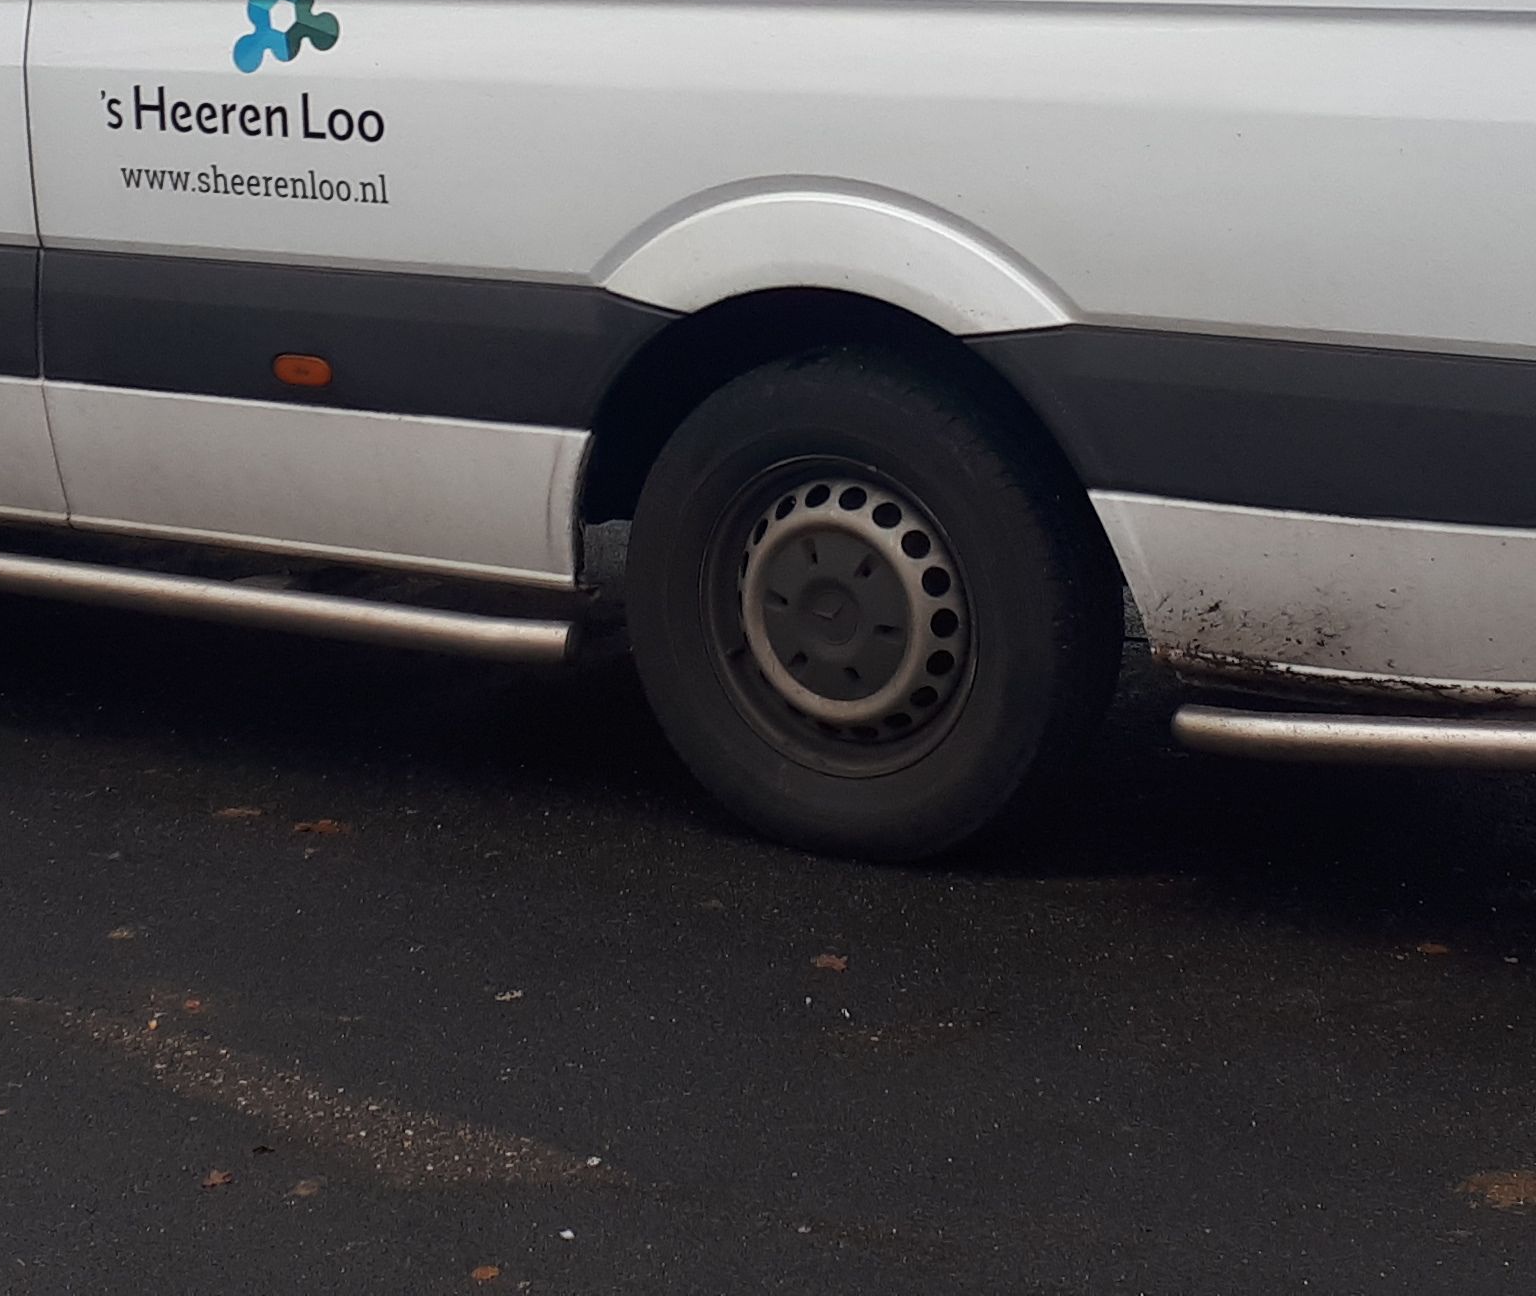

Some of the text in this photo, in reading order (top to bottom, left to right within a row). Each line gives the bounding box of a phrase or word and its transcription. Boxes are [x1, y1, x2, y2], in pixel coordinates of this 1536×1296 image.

[133, 82, 289, 138] Heeren
[300, 92, 384, 143] Loo
[120, 164, 390, 205] www.sheerenloo.nl
